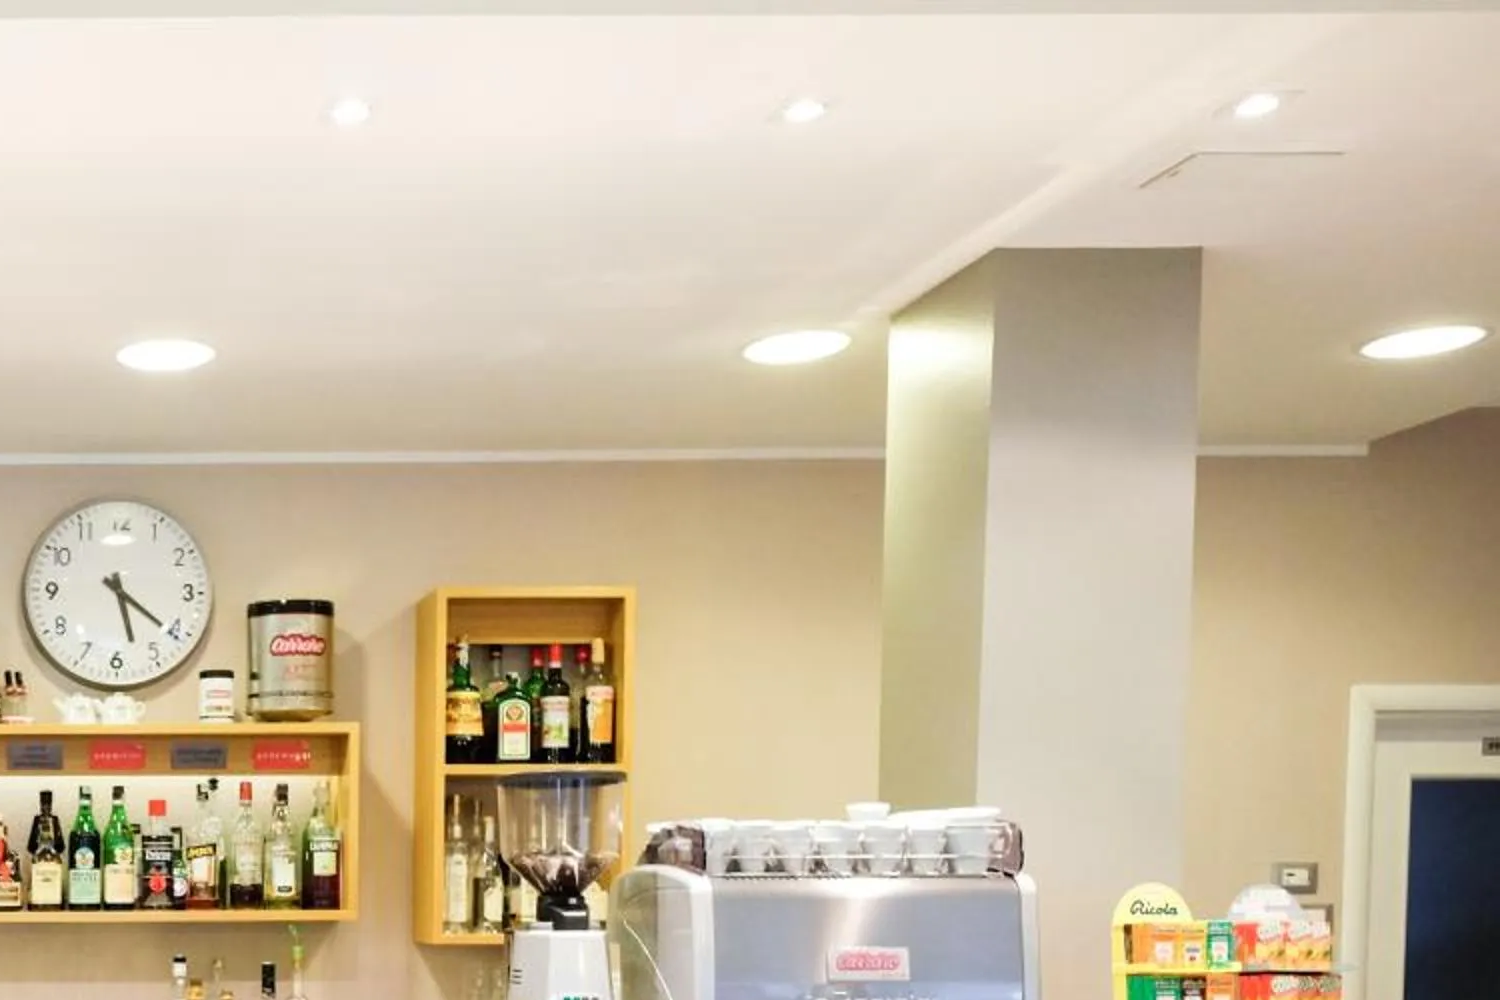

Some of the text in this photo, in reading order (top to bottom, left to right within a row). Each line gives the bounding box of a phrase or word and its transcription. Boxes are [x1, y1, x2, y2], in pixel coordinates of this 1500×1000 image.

[78, 522, 93, 541] 11
[54, 547, 71, 567] 10
[173, 547, 185, 567] 2
[45, 581, 59, 600] 9
[182, 583, 194, 602] 3
[54, 616, 67, 636] 8
[80, 641, 93, 661] 7
[148, 642, 160, 662] 5
[109, 652, 123, 670] 6
[1130, 900, 1178, 917] Ricola
